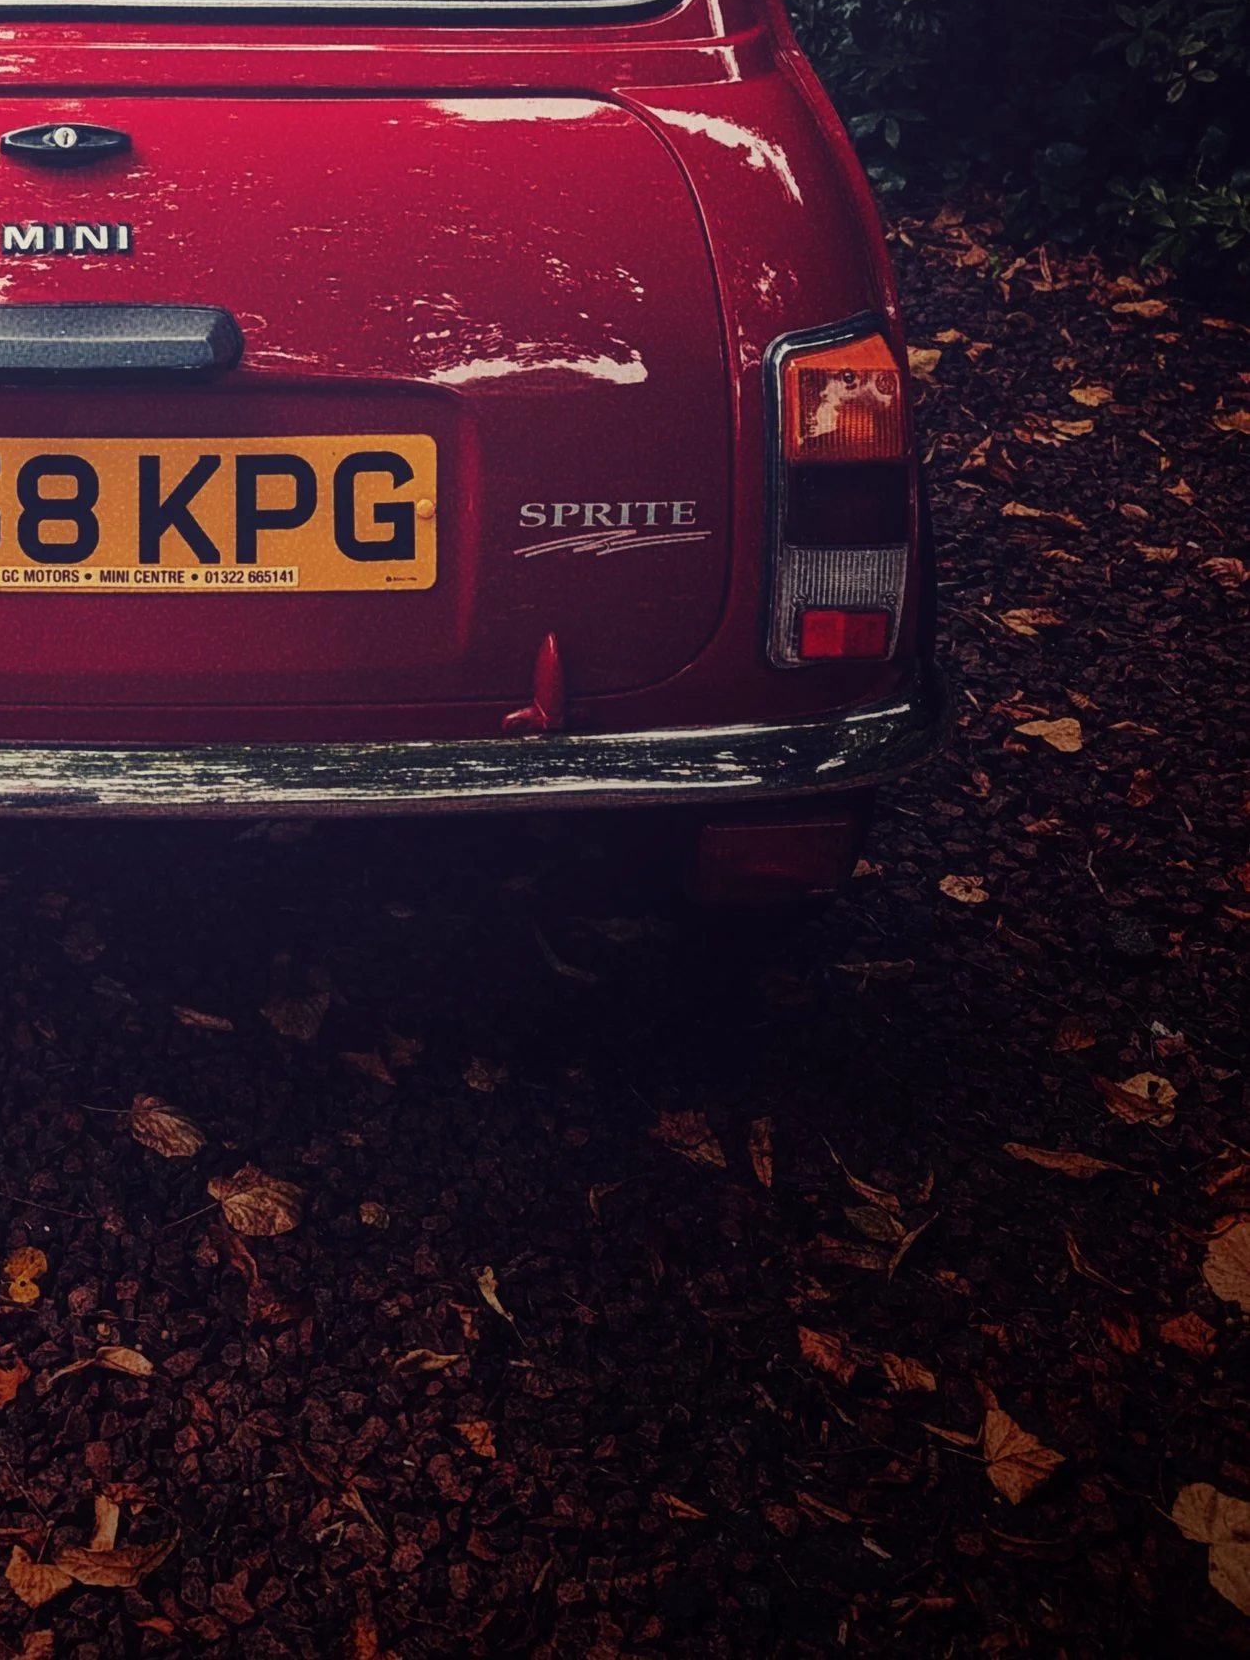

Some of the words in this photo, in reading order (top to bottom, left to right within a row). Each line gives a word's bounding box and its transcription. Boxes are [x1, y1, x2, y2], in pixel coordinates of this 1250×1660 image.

[3, 225, 129, 251] MINI
[137, 450, 418, 565] KPG
[519, 500, 697, 527] SPRITE
[1, 569, 20, 583] GC
[23, 569, 80, 583] MOTORS
[99, 569, 130, 583] MINI
[133, 569, 185, 583] CENTRE
[204, 570, 245, 584] 01322
[248, 569, 295, 584] 665141
